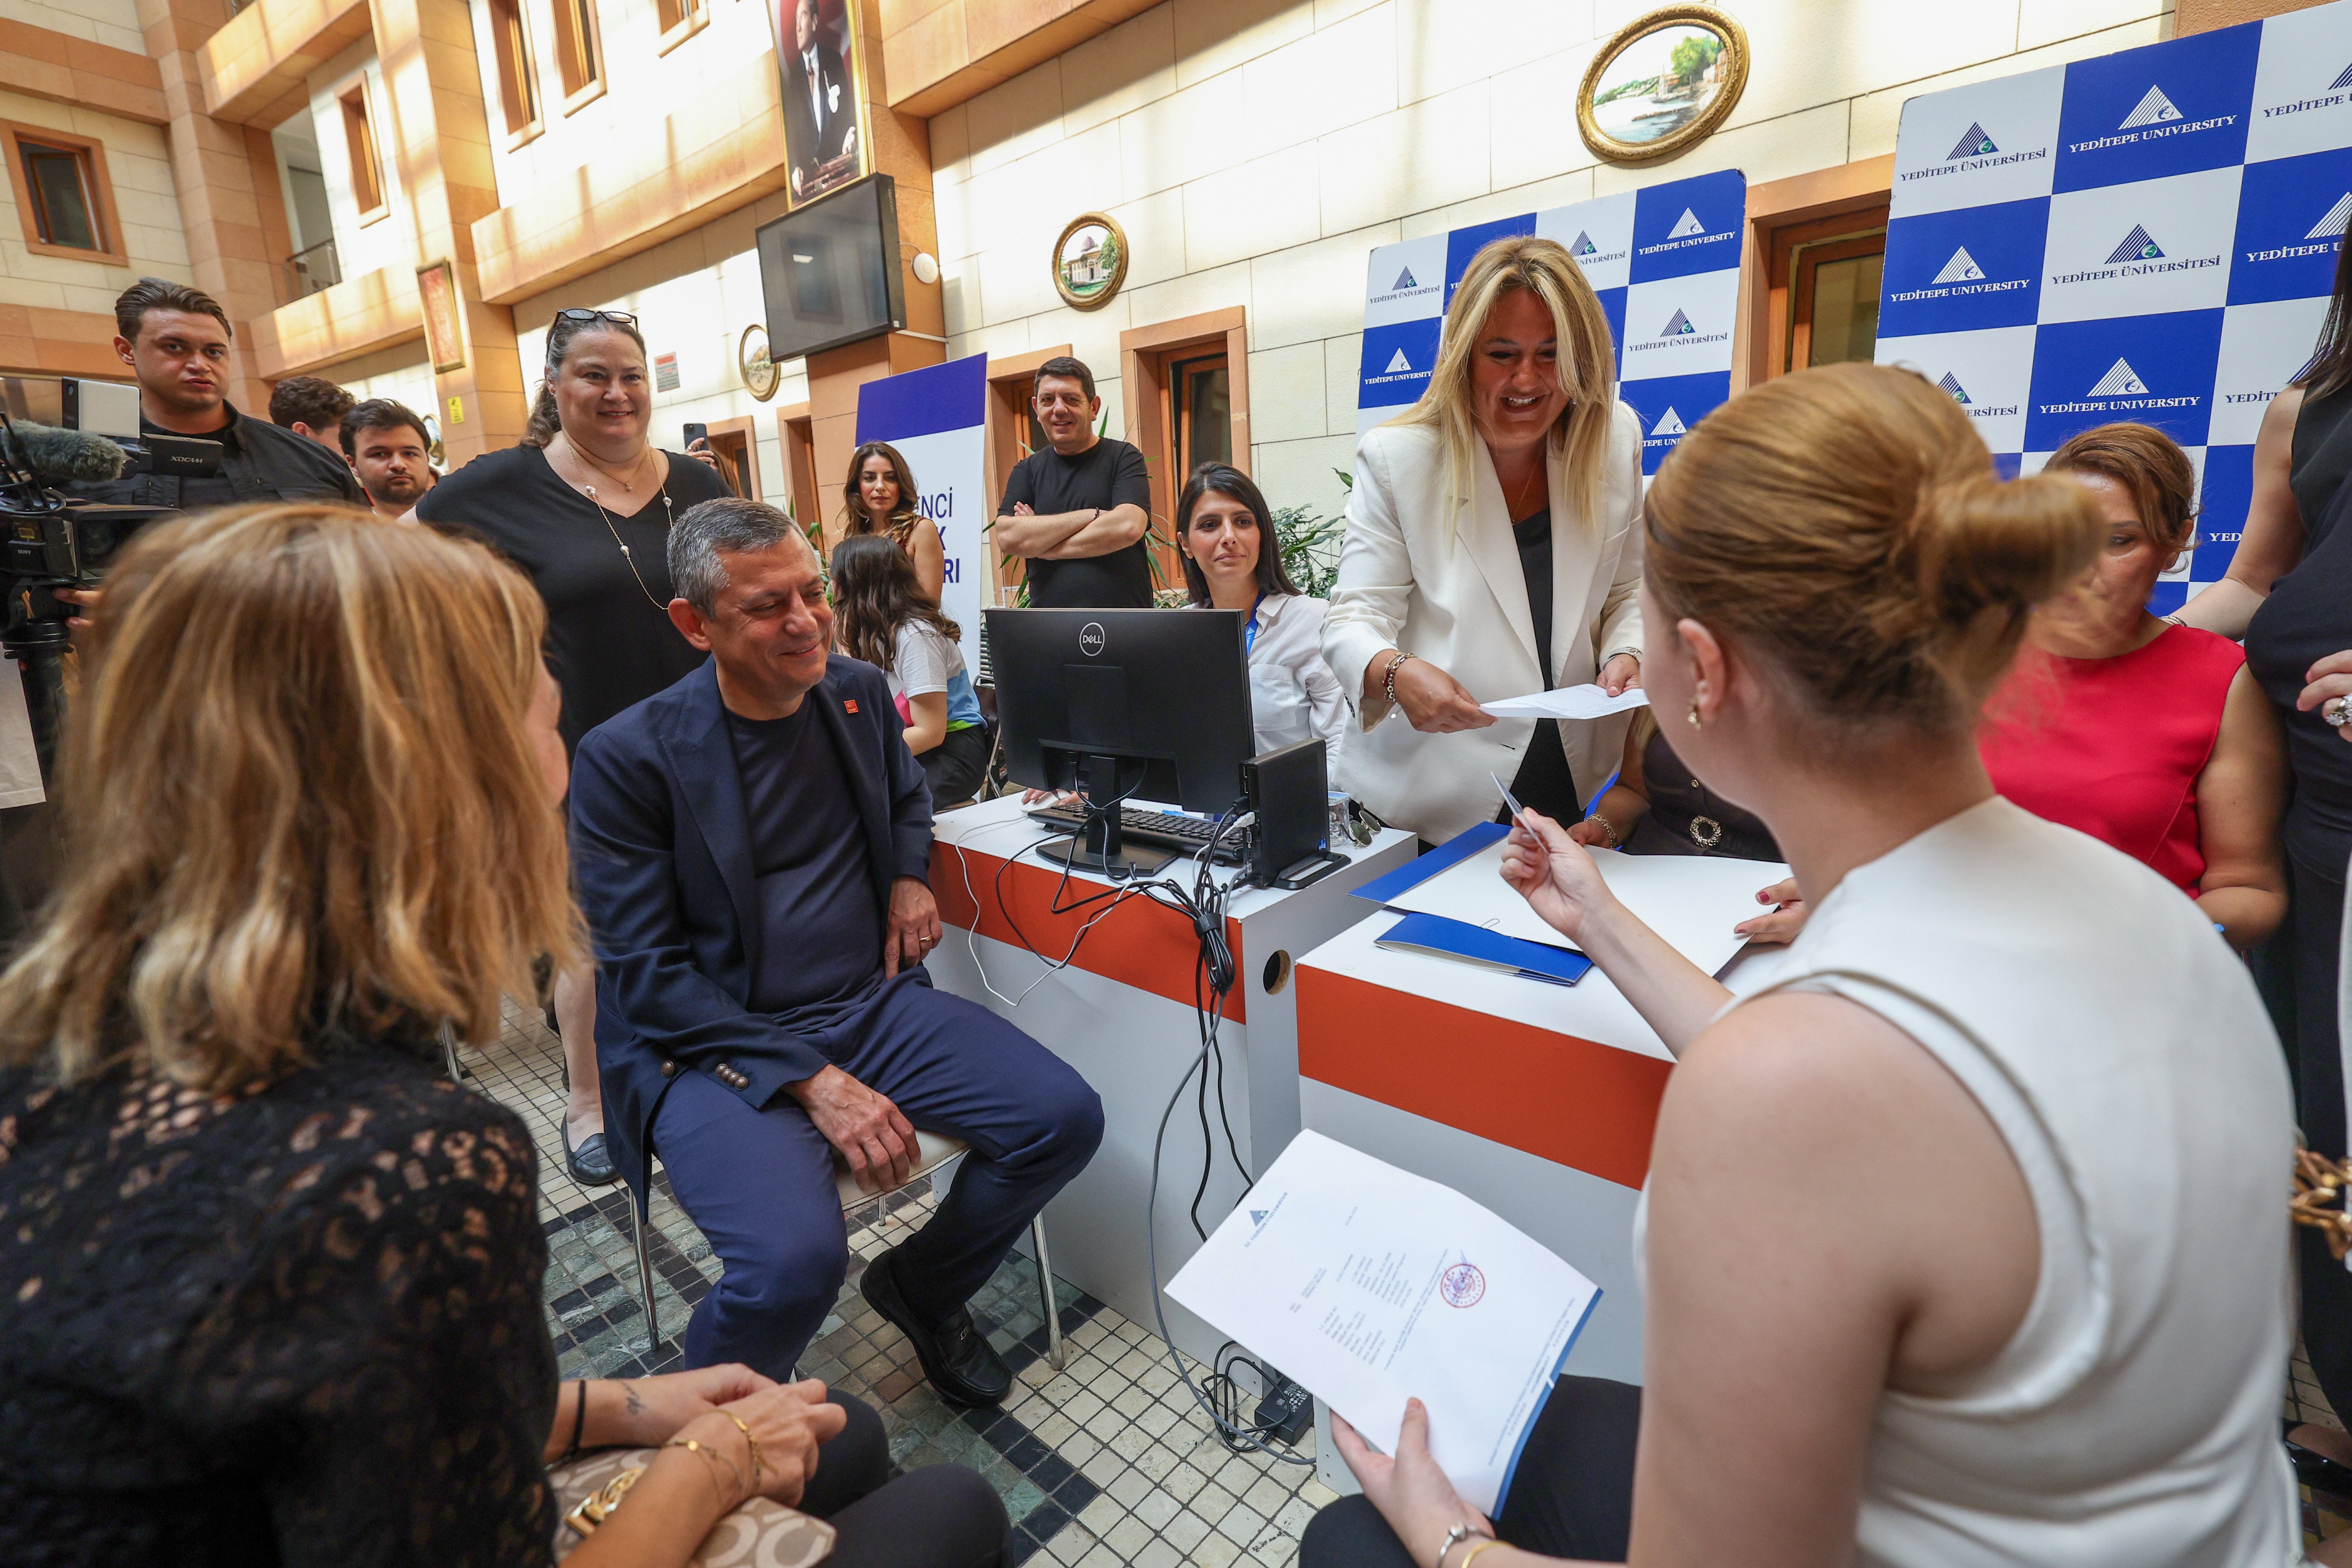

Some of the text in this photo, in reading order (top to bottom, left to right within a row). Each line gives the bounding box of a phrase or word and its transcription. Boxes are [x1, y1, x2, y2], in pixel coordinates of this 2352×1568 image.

[2263, 95, 2344, 118] YEDİTEPE
[2069, 115, 2237, 153] YEDİTEPE UNIVERSITY
[1901, 148, 2047, 181] YEDİTEPE ÜNİVERSİTESİ
[1639, 231, 1736, 255] YEDİTEPE UNIVERSITY
[2246, 243, 2328, 262] YEDİTEPE
[2052, 255, 2221, 284] YEDİTEPE ÜNİVERSİTESİ
[1370, 294, 1398, 303] YEDİTEPE
[1399, 285, 1440, 298] ÜNİVERSİTESİ
[1890, 279, 2030, 302] YEDİTEPE UNIVERSITY
[1629, 341, 1668, 351] YEDİTEPE
[1670, 332, 1728, 347] ÜNİVERSİTESİ
[1364, 371, 1432, 384] YEDİTEPE UNIVERSITY
[2040, 397, 2200, 414] YEDİTEPE UNIVERSITY
[2225, 391, 2280, 403] YEDİT
[1966, 405, 2018, 417] ERSİTESİ
[918, 487, 952, 518] NCİ
[943, 558, 960, 583] RI
[1082, 635, 1102, 644] DELL
